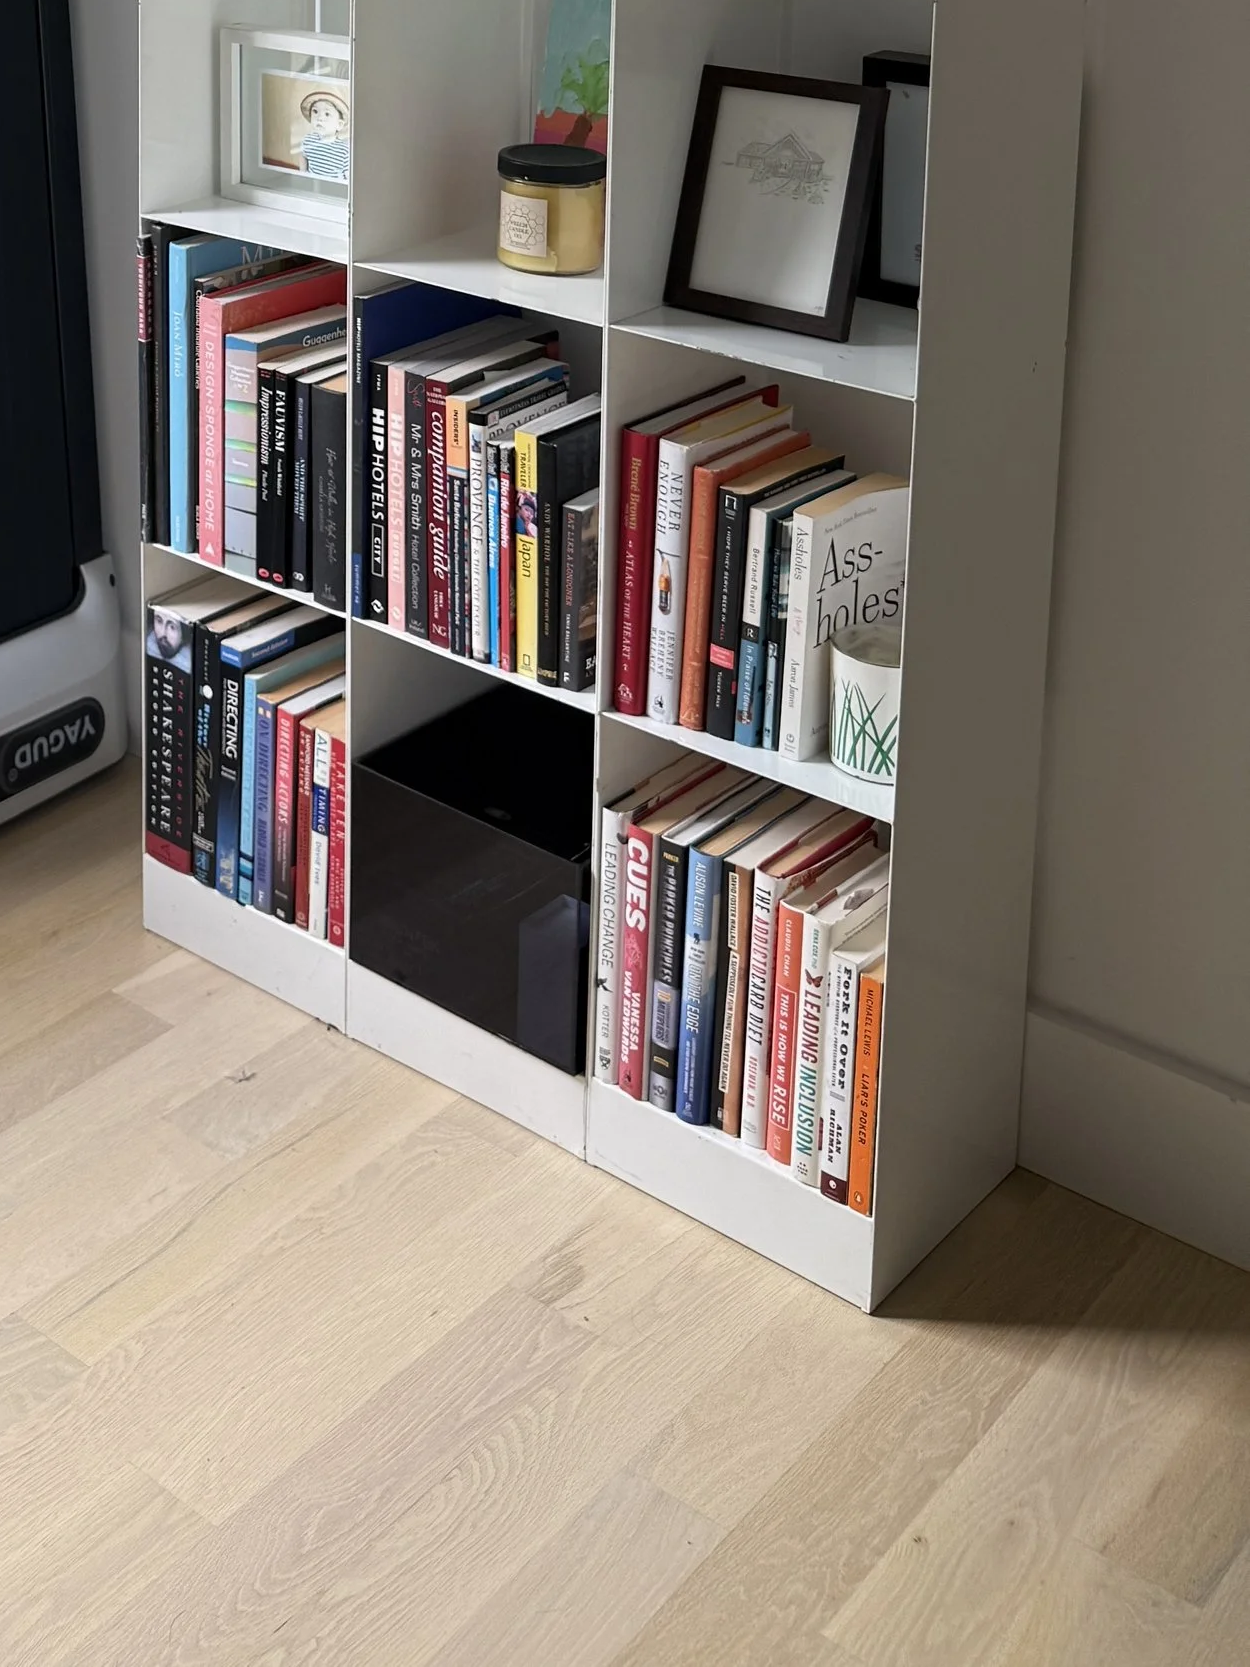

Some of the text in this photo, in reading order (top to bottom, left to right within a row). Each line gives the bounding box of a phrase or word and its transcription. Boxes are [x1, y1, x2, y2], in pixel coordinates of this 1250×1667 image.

[260, 386, 273, 464] Impressionism
[275, 390, 285, 452] FAUVISM
[373, 408, 383, 520] HIP HOTELS
[391, 413, 401, 525] HIP HOTELS
[429, 412, 448, 581] companion guide
[629, 458, 641, 530] Brené Brown
[411, 424, 421, 608] Mr & Mrs Smith Hotel Collection
[500, 478, 509, 547] Rio de Janeiro
[657, 460, 669, 535] ENOUGH
[669, 472, 683, 531] NEVER
[488, 494, 496, 568] Buenos Aires
[519, 539, 535, 577] Japan
[795, 527, 807, 580] Assholes
[565, 563, 573, 606] LONDONER
[625, 552, 634, 586] ATLAS
[749, 548, 760, 614] Bertrand Russell
[817, 537, 883, 594] Ass-
[623, 622, 632, 659] HEART
[658, 629, 666, 676] BREHENY
[666, 630, 676, 681] JENNIFER
[14, 713, 97, 771] YAGUD
[160, 669, 173, 833] SHAKESPEARE
[226, 679, 238, 759] DIRECTING
[317, 735, 326, 767] ALL
[278, 719, 289, 824] DIRECTING ACTORS
[318, 789, 326, 832] TIMING
[602, 843, 616, 968] LEADING CHANGE
[626, 837, 648, 931] CUES
[694, 862, 705, 928] ALISON LEVINE
[749, 888, 770, 1046] THE ADDICTOCARB DIET
[784, 920, 792, 952] CLAUDIA
[688, 986, 701, 1003] THE
[690, 965, 702, 983] ON
[602, 1005, 610, 1037] KOTTER
[621, 971, 632, 1063] VAN EDWARDS
[630, 992, 640, 1050] VANESSA
[686, 1006, 700, 1033] EDGE
[838, 967, 852, 1089] Fork It Over
[863, 988, 874, 1056] MICHAEL LEWIS
[772, 994, 790, 1124] THIS IS HOW WE RISE
[796, 990, 820, 1155] LEADING INCLUSION
[828, 1109, 836, 1162] RICHMAN
[858, 1074, 870, 1144] LIAR'S POKER
